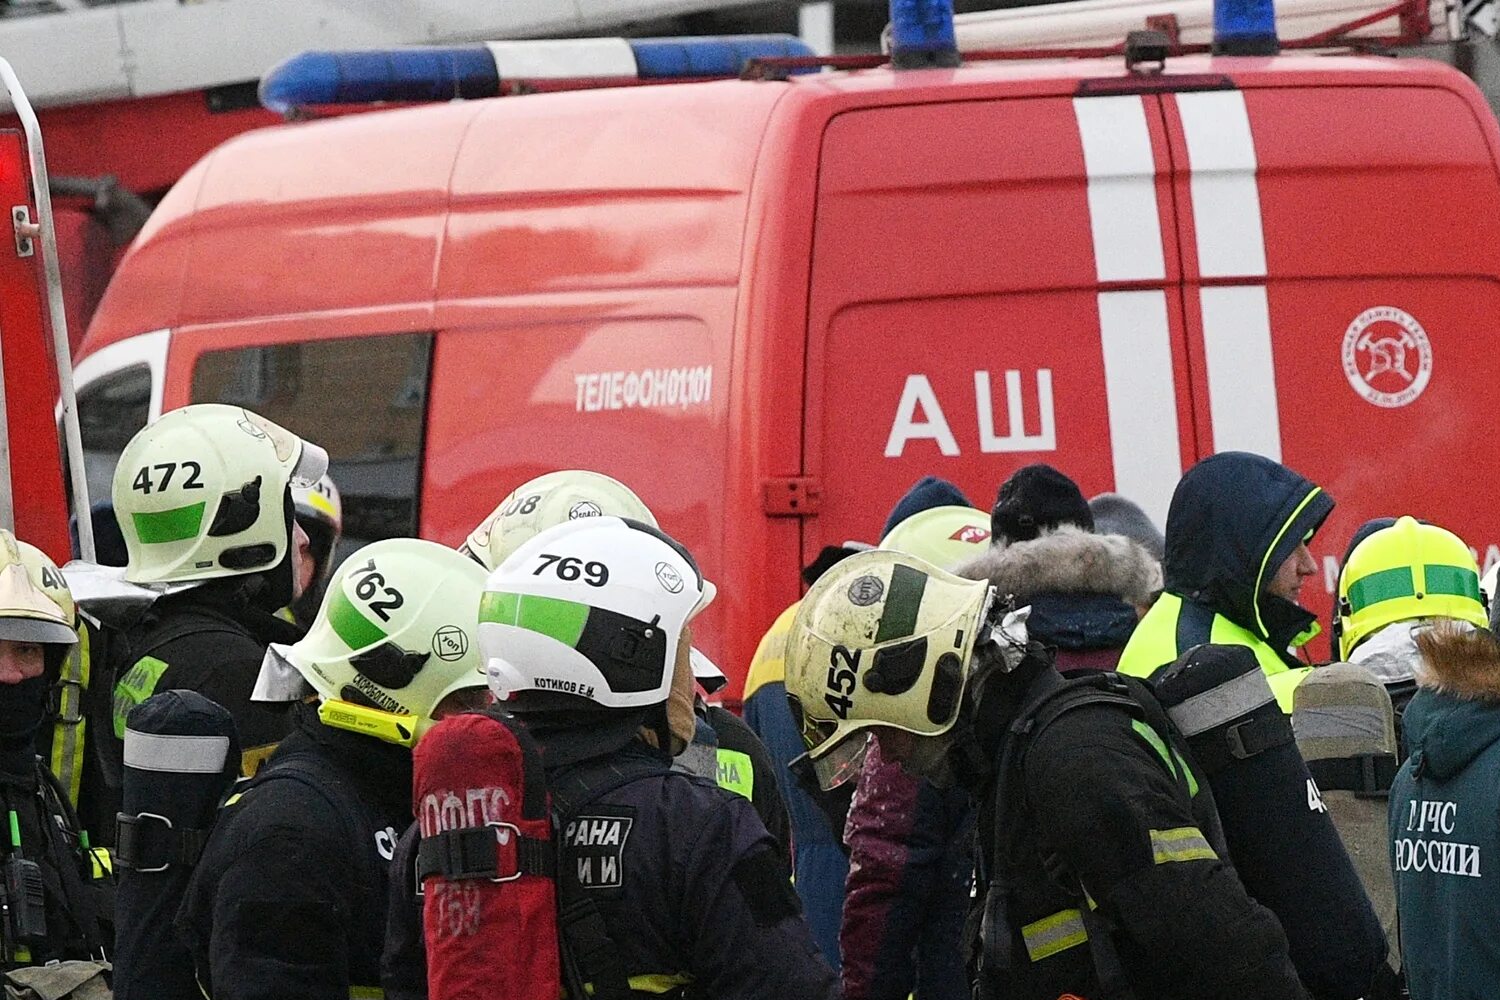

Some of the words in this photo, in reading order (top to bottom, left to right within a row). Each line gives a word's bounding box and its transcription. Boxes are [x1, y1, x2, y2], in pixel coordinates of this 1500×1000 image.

[883, 367, 1057, 458] АШ
[132, 461, 204, 495] 472
[348, 558, 404, 623] 762
[532, 554, 610, 588] 769
[534, 677, 577, 692] КОТИКОВ
[824, 644, 862, 720] 452
